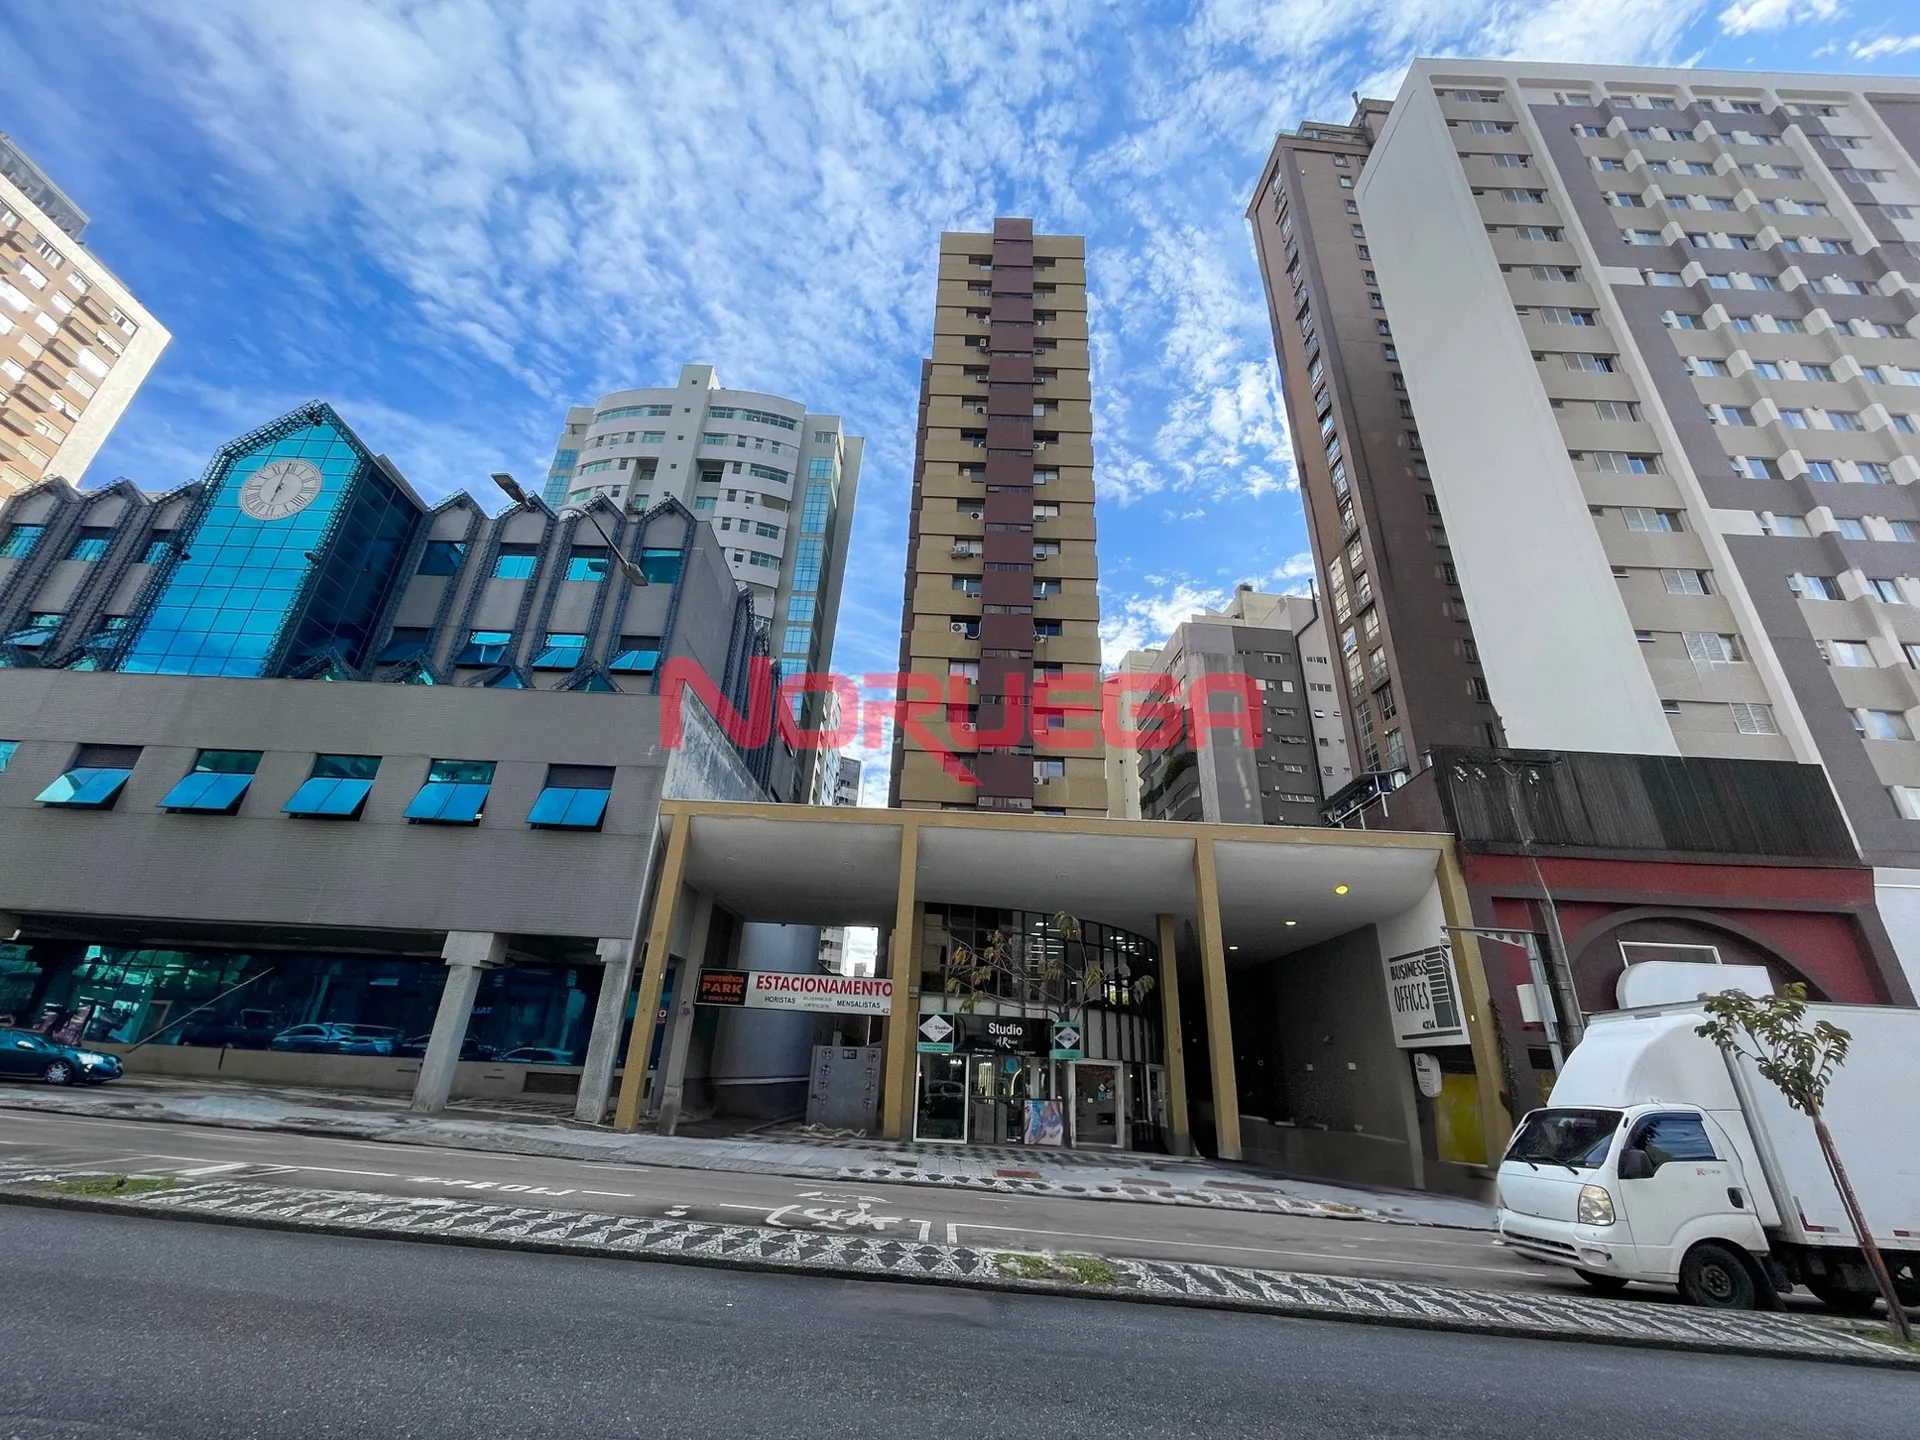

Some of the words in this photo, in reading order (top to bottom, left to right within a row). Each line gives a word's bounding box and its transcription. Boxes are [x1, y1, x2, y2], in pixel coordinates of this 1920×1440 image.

[1390, 960, 1428, 980] BUSINESS
[702, 982, 743, 994] PARK
[756, 975, 893, 997] ESTACIONAMENTO
[764, 995, 796, 1005] HORISTAS
[836, 1000, 881, 1009] MENSALISTAS
[1394, 982, 1430, 1013] OFFICES
[988, 1022, 1023, 1036] Studio
